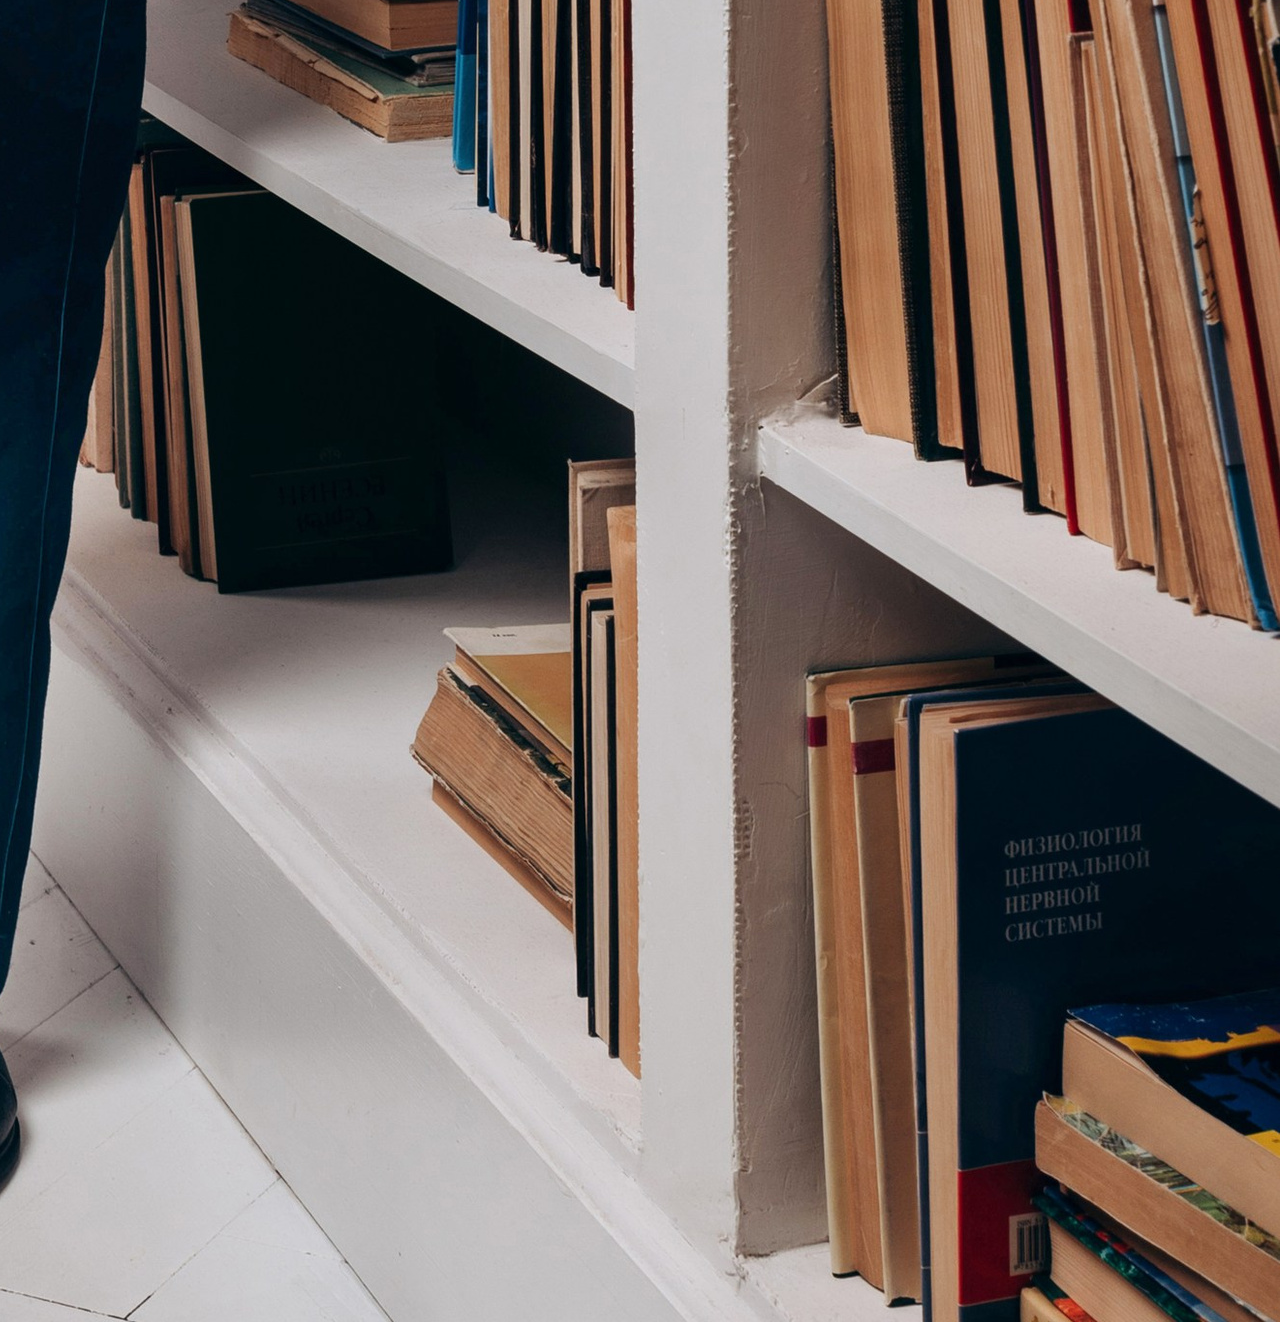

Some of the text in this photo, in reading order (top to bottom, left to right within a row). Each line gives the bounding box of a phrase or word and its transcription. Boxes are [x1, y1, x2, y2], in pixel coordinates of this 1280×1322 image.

[1004, 823, 1142, 858] ФИЗИОЛОГИЯ
[1004, 846, 1151, 889] ЦЕНТРАЛЬНОЙ
[1004, 881, 1100, 915] НЕРВНОЙ
[1004, 912, 1103, 943] СИСТЕМЫ
